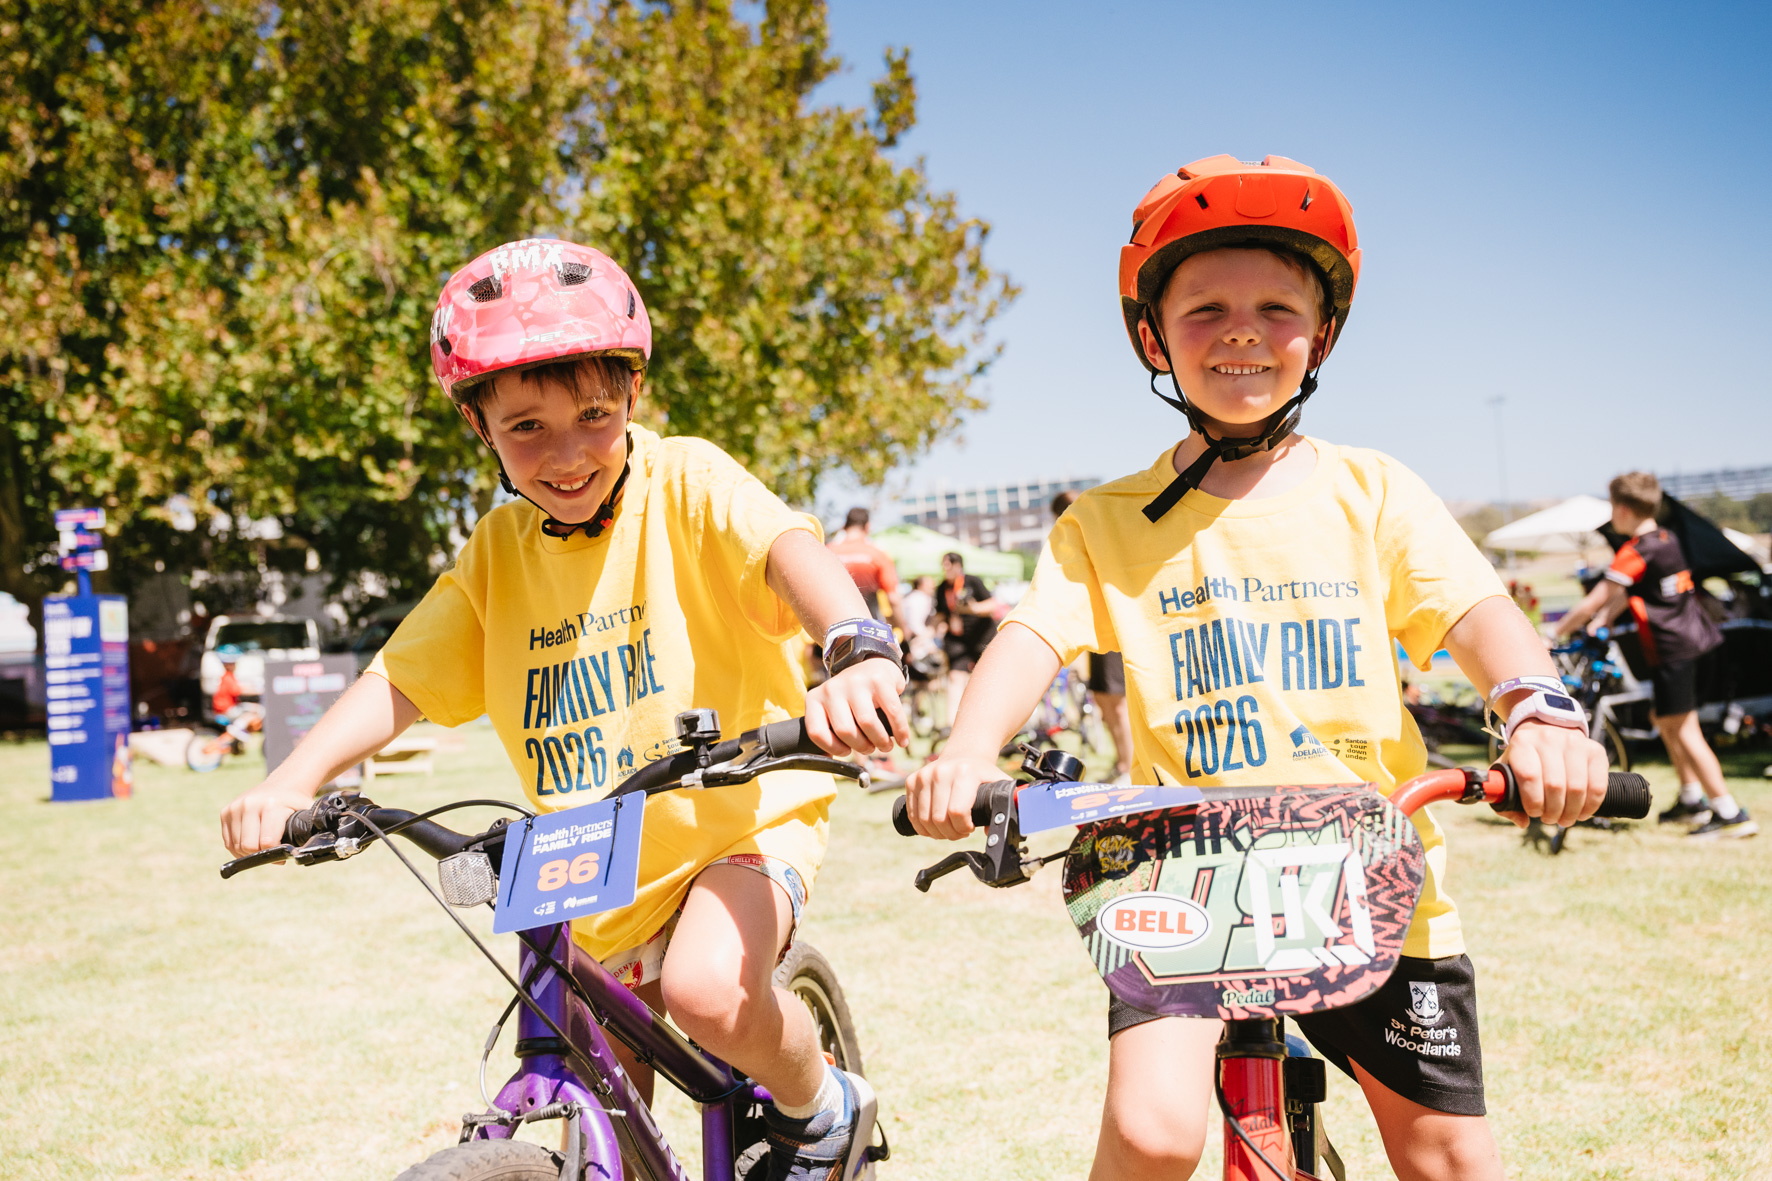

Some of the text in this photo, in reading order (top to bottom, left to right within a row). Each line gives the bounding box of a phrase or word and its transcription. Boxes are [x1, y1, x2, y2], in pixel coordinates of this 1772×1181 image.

[489, 244, 564, 280] BMX
[519, 330, 565, 345] MET
[1158, 576, 1359, 615] Health Partners
[576, 600, 646, 637] Partn
[1169, 617, 1365, 701] FAMILY RIDE
[523, 650, 616, 729] FAMILY
[1174, 695, 1267, 779] 2026
[525, 726, 607, 796] 2026
[1071, 788, 1145, 810] 87
[532, 828, 611, 855] FAMILY RIDE
[533, 818, 613, 846] Health Partners
[537, 852, 600, 892] 86
[1114, 909, 1194, 935] BELL
[1222, 988, 1275, 1008] Pedal
[1384, 1027, 1462, 1057] Woodlands
[1391, 1018, 1406, 1032] St
[1410, 1026, 1458, 1040] Peter's
